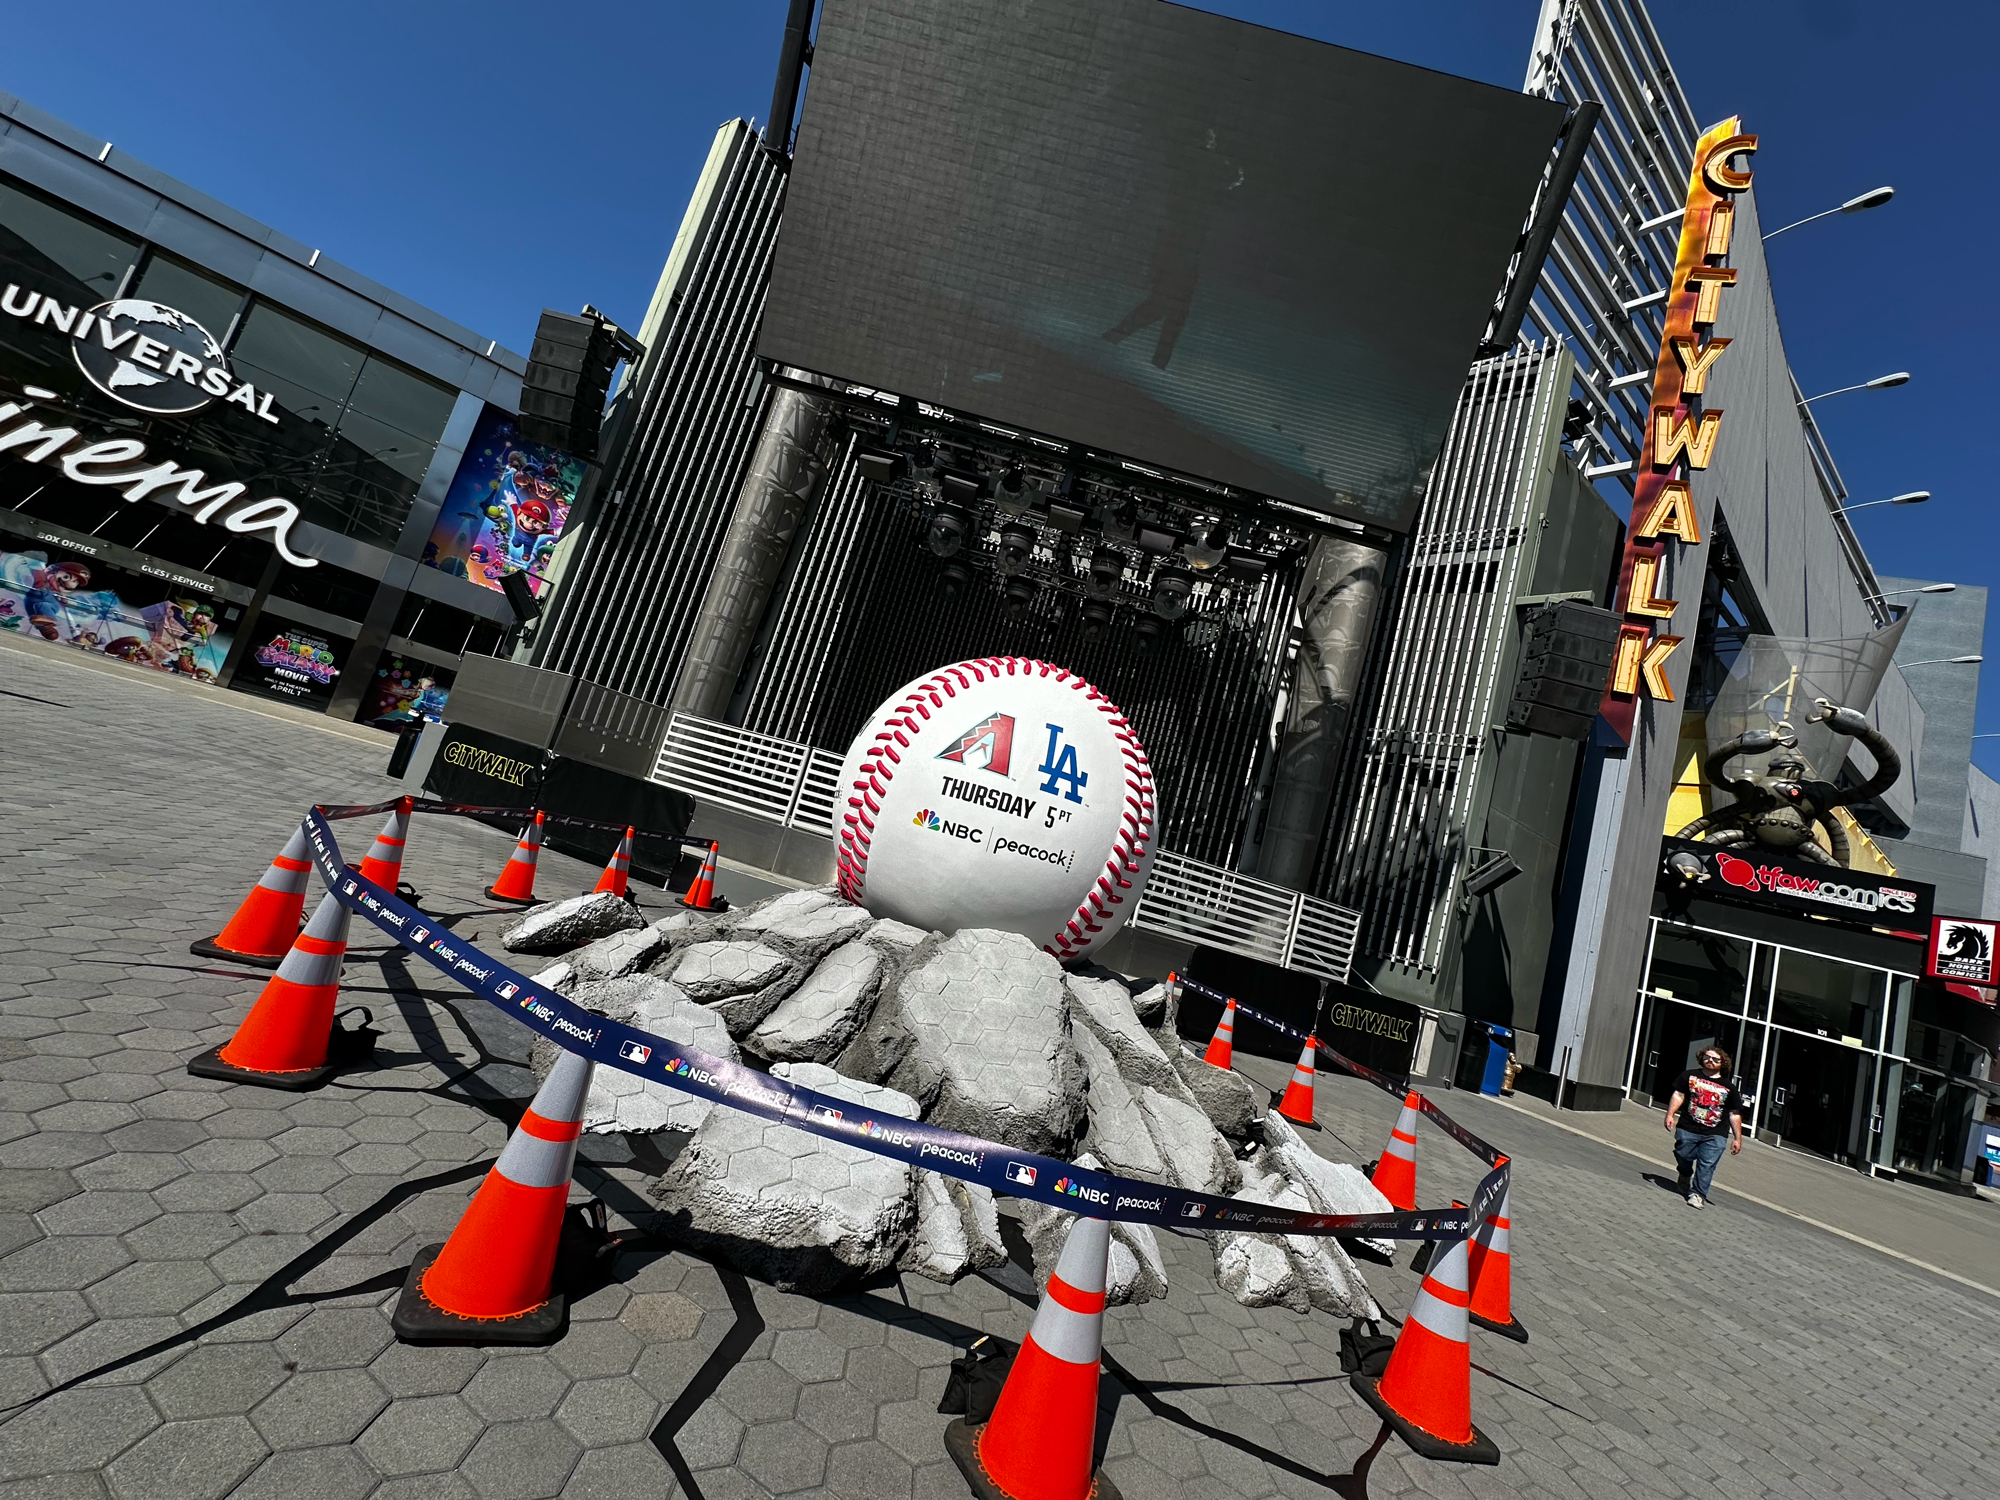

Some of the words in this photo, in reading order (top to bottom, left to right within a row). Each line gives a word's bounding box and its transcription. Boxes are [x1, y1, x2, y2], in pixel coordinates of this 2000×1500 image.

[1, 283, 281, 424] UNIVERSAL
[1611, 133, 1759, 702] CITYWALK
[0, 385, 319, 568] inema
[37, 532, 60, 544] BOX
[62, 539, 97, 555] OFFICE
[141, 564, 170, 579] GUEST
[172, 574, 215, 592] SERVICES
[269, 636, 335, 665] MARIO
[301, 637, 329, 651] SUPER
[264, 677, 278, 685] ONLY
[286, 682, 311, 693] THEATERS
[274, 667, 309, 683] MOVIE
[270, 684, 295, 695] APRIL
[443, 741, 532, 786] CITYWALK
[1038, 722, 1088, 805] LA
[941, 776, 1037, 819] THURSDAY
[942, 822, 983, 843] NBC
[993, 837, 1068, 868] peacock
[1821, 895, 1851, 907] ANOTHER
[1851, 901, 1877, 912] WORLD
[1880, 887, 1900, 896] SINCE
[1900, 890, 1917, 899] 1979
[366, 897, 381, 912] NBC
[377, 907, 405, 928] peacock
[438, 946, 459, 962] NBC
[454, 958, 488, 981] peacock
[1942, 969, 1984, 979] COMICS
[1948, 963, 1984, 972] HORSE
[1954, 956, 1985, 965] DARK
[532, 1004, 555, 1022] NBC
[551, 1017, 594, 1044] peacock
[1331, 1002, 1412, 1043] CITYWALK
[687, 1067, 719, 1087] NBC
[724, 1080, 783, 1107] peacock
[881, 1129, 912, 1149] NBC
[920, 1142, 978, 1168] peacock
[1078, 1186, 1110, 1205] NBC
[1115, 1196, 1162, 1212] peacock
[1231, 1212, 1254, 1222] NBC
[1256, 1215, 1295, 1226] peacock
[1347, 1221, 1366, 1229] NBC
[1368, 1220, 1399, 1231] peacock
[1443, 1220, 1458, 1231] NBC
